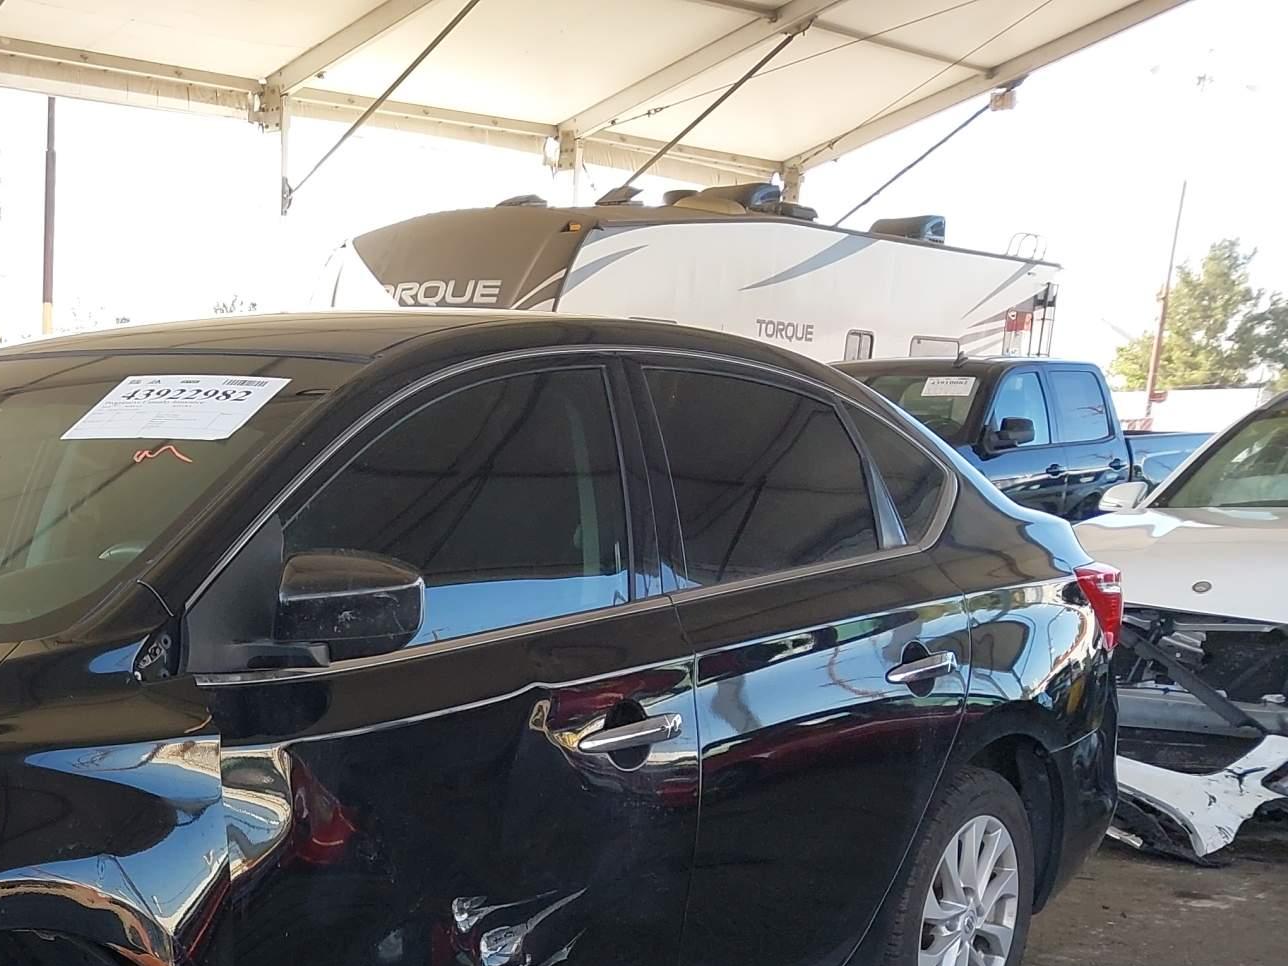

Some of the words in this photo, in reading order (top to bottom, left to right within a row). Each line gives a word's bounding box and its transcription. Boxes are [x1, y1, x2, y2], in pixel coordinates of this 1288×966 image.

[383, 279, 502, 306] RQUE
[756, 319, 814, 342] TORQUE
[121, 388, 253, 402] 43922982
